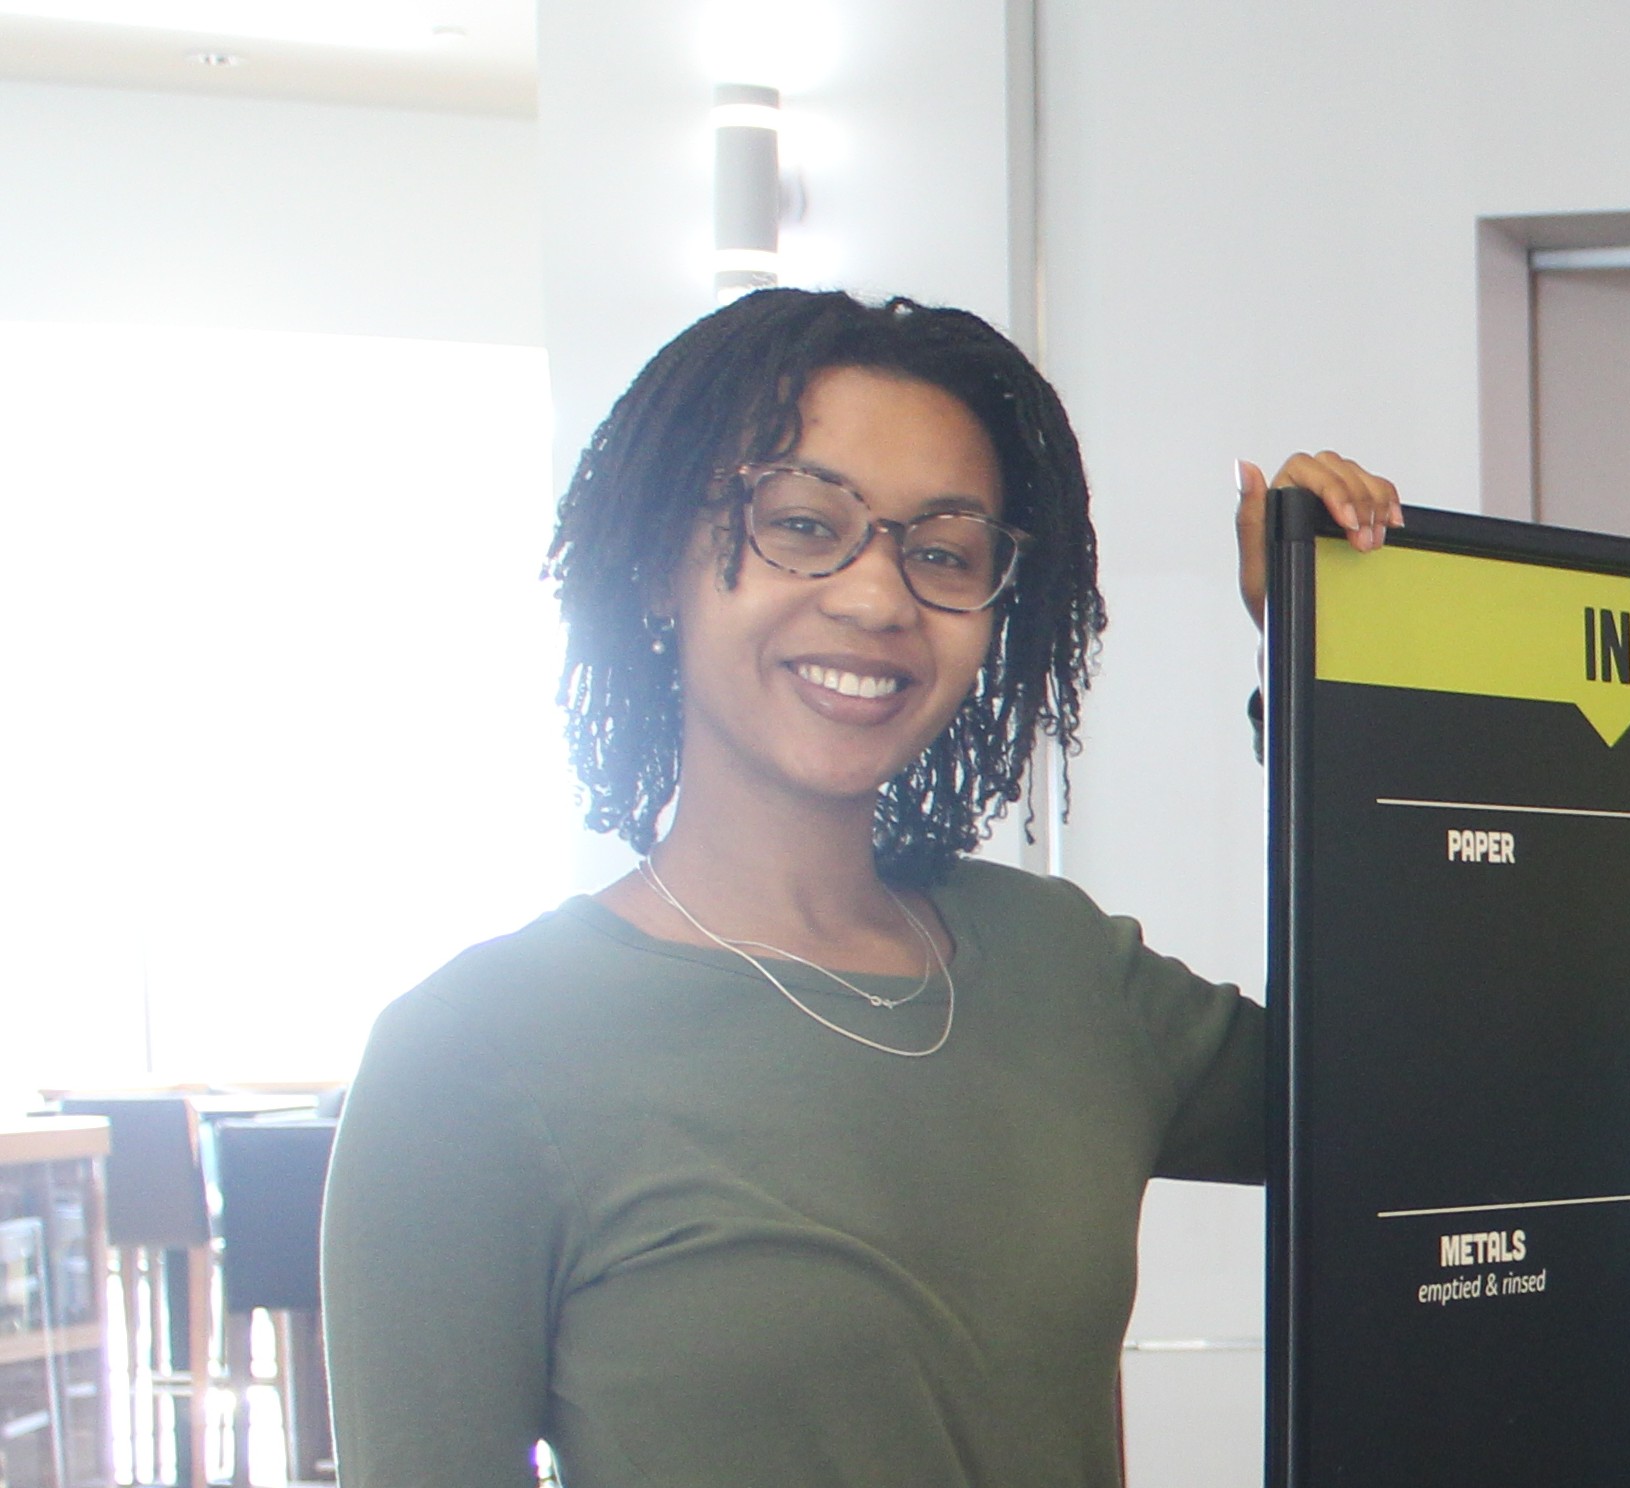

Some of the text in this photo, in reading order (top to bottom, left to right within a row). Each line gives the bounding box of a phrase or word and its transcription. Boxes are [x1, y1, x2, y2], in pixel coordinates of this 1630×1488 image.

[1447, 829, 1516, 864] PAPER
[1440, 1229, 1527, 1267] METALS
[1418, 1268, 1547, 1306] emptied & rinsed
